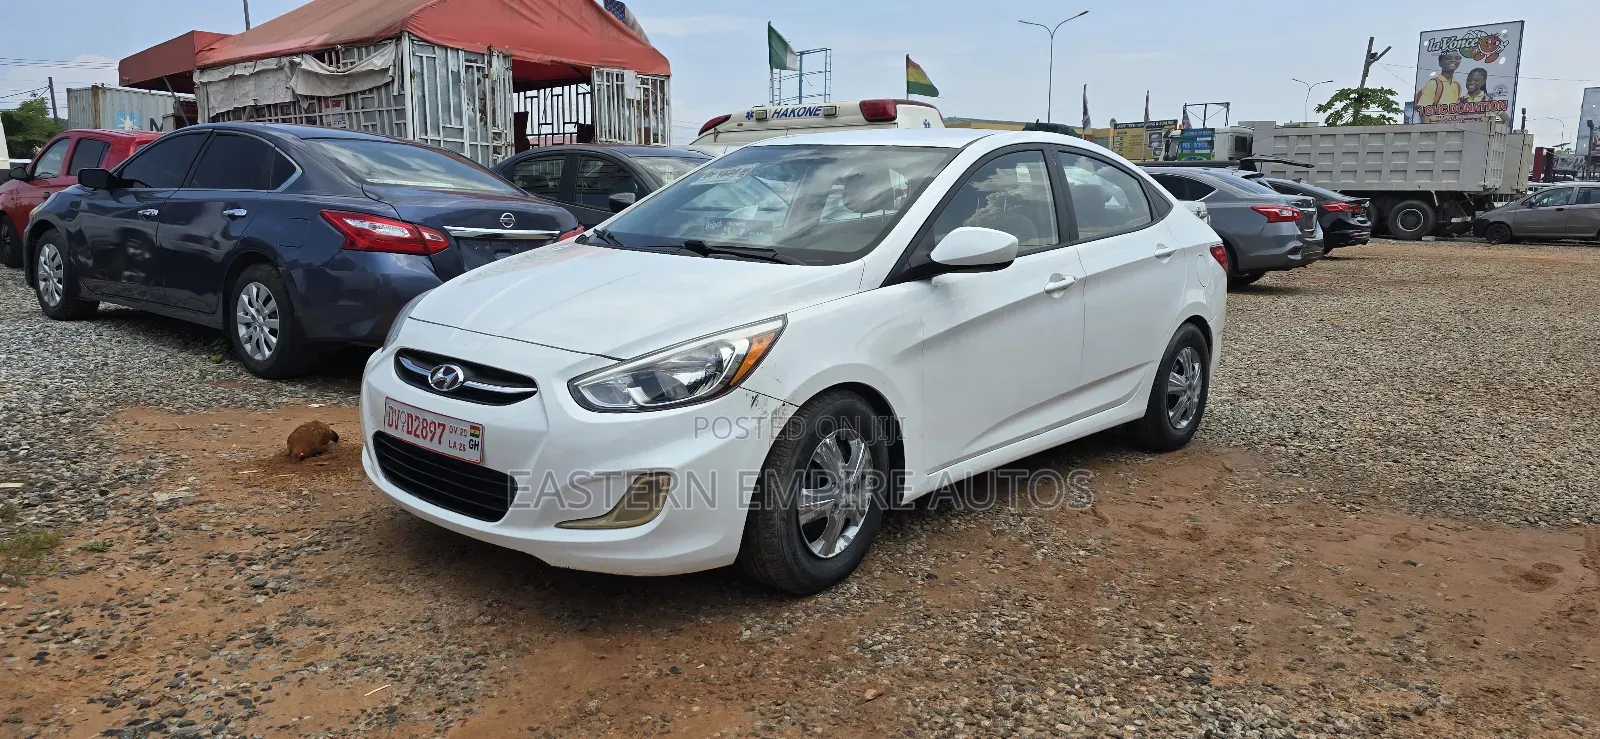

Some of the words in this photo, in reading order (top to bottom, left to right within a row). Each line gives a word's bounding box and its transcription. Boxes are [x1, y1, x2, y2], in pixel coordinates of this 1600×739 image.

[771, 106, 824, 118] HAKONE
[1449, 100, 1508, 114] DONATION
[387, 405, 400, 430] DV
[406, 412, 446, 445] D2897
[448, 424, 459, 434] DV
[448, 440, 457, 450] LA
[468, 439, 480, 451] GH
